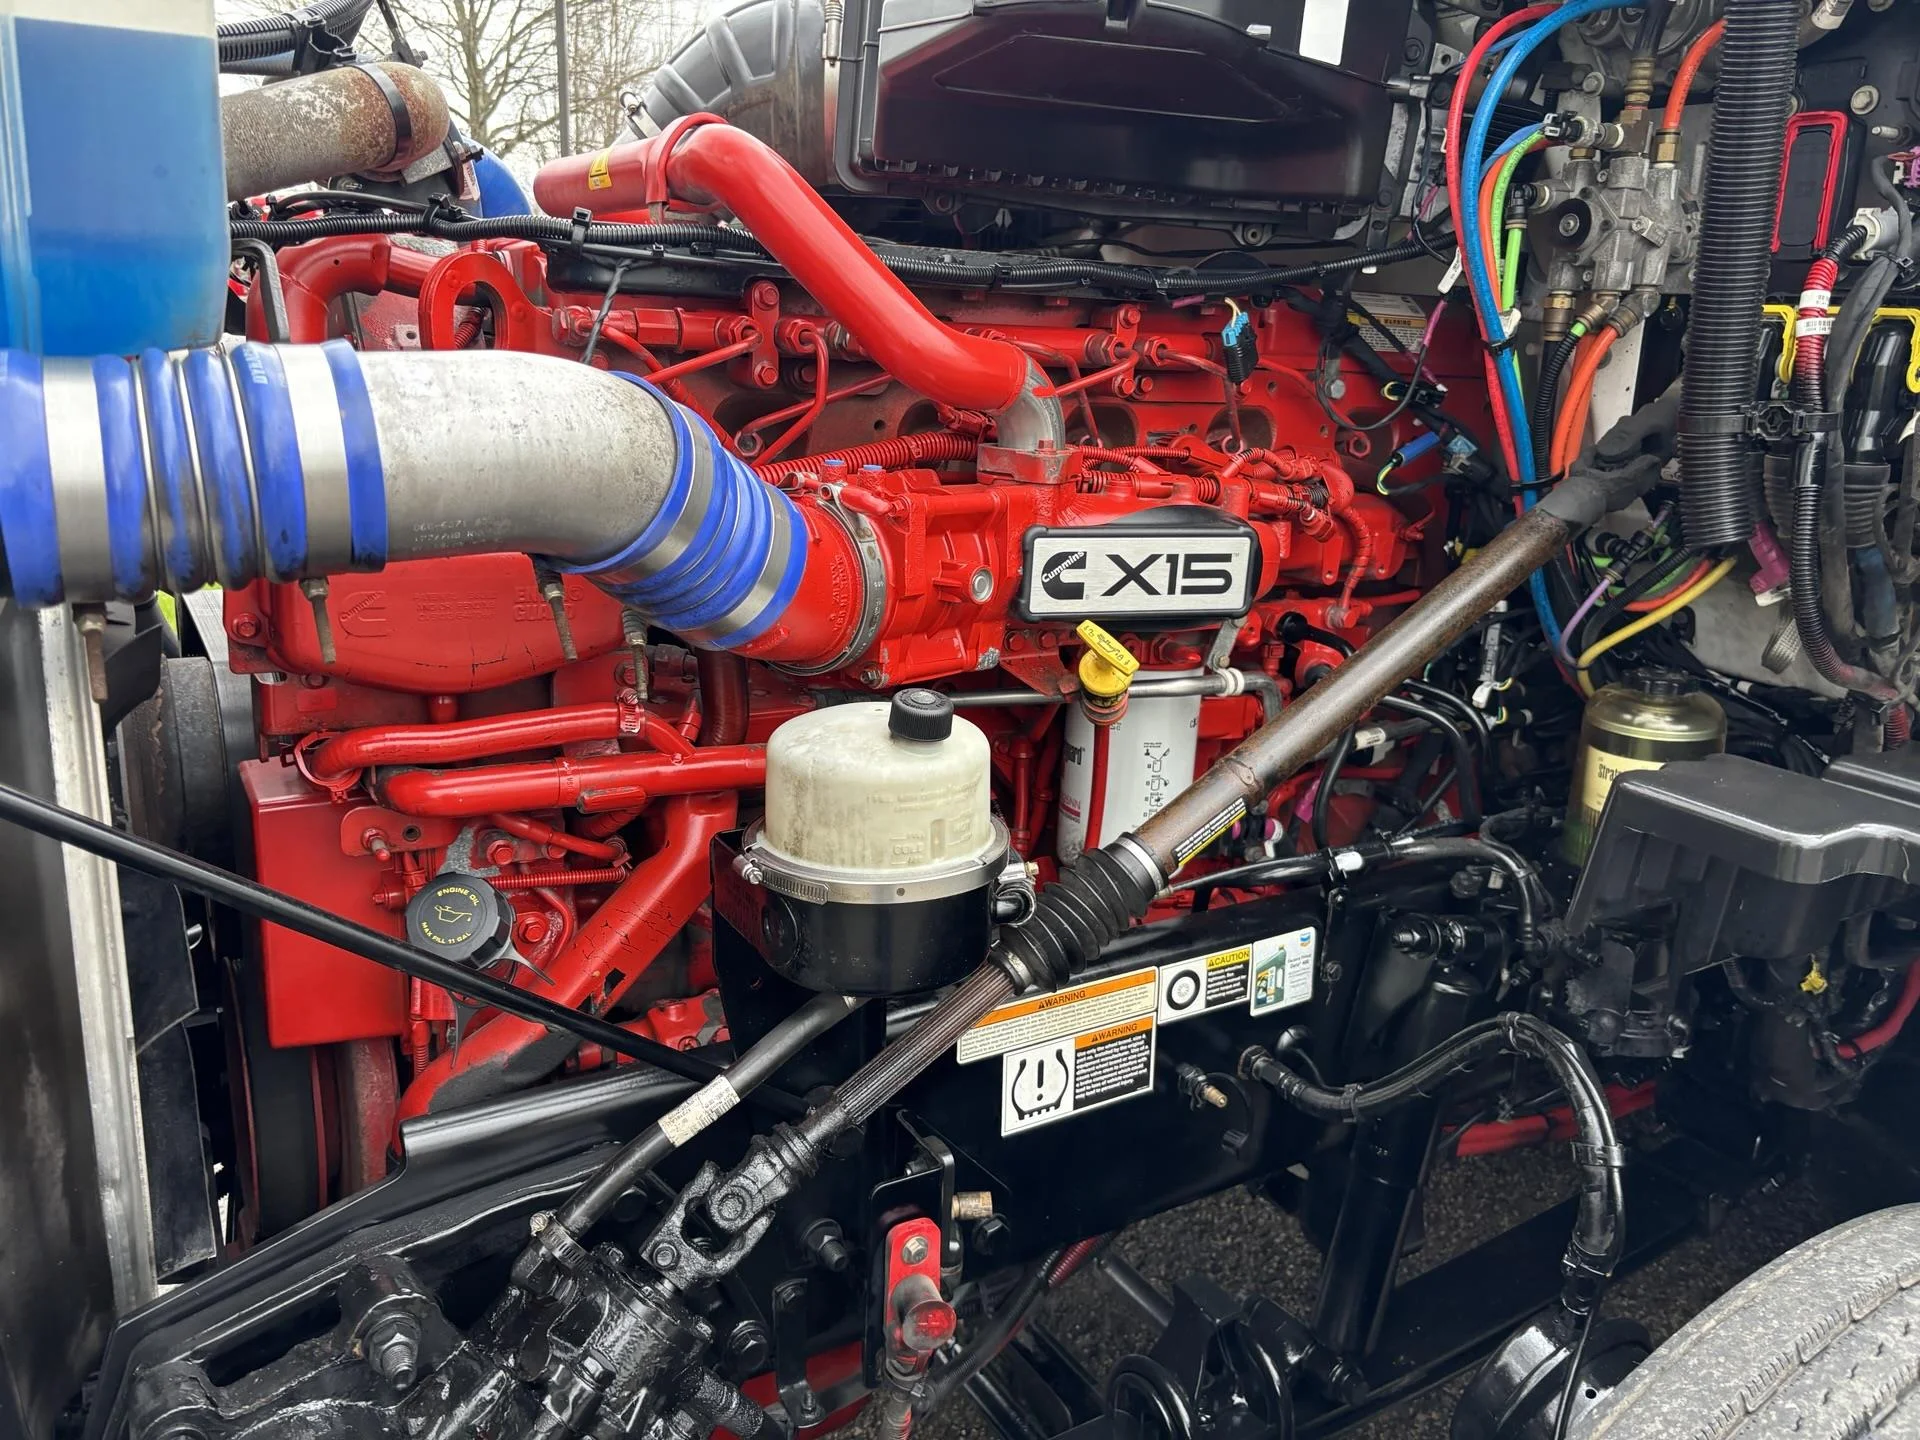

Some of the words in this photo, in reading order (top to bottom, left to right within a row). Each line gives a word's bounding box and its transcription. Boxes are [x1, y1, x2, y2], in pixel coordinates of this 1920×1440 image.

[1042, 550, 1085, 583] Cummins
[1100, 553, 1233, 597] X15
[436, 887, 470, 897] ENGINE
[469, 894, 480, 907] OIL
[421, 921, 433, 937] MAX
[431, 935, 446, 944] FILL
[456, 932, 472, 942] GAL
[1214, 951, 1249, 966] CAUTION
[1045, 990, 1086, 1007] WARNING
[1098, 1023, 1138, 1041] WARNING
